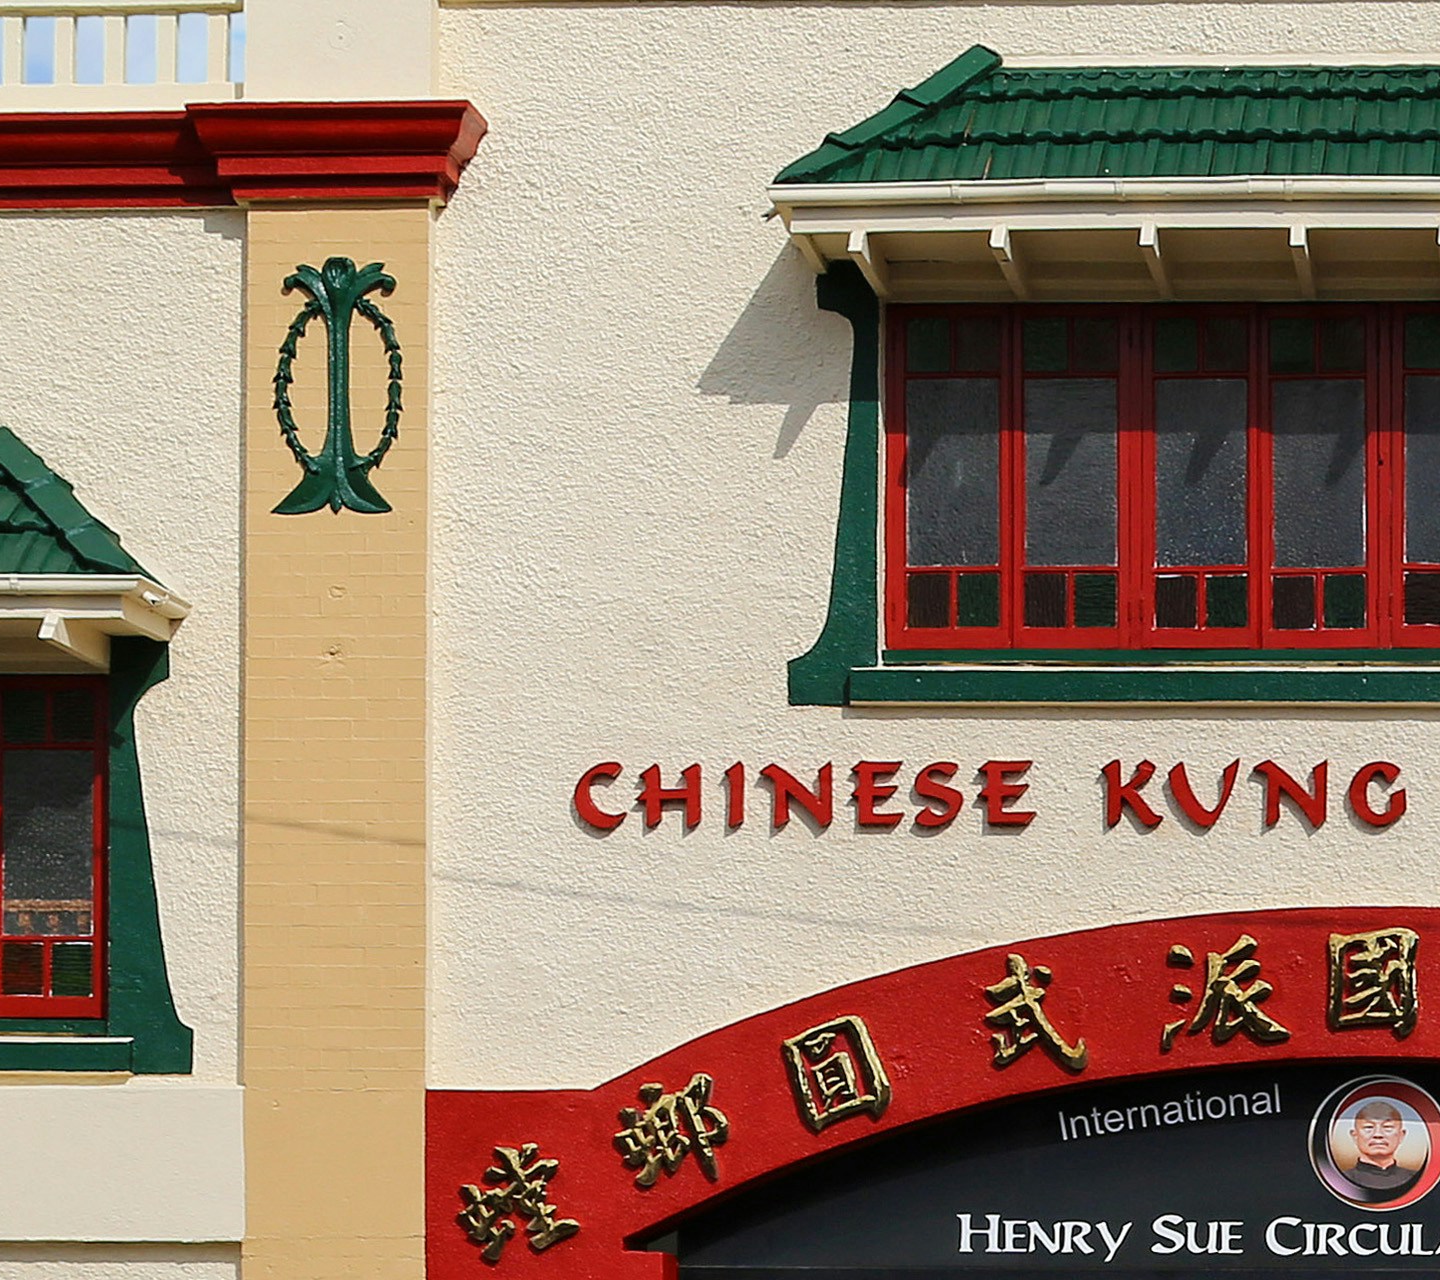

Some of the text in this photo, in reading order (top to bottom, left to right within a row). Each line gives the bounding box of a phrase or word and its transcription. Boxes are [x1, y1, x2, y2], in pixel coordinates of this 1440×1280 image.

[573, 758, 1037, 830] CHINESE
[1100, 757, 1408, 829] KUNG
[1058, 1083, 1283, 1143] International
[956, 1212, 1133, 1263] HENRY
[1150, 1213, 1244, 1257] SUE
